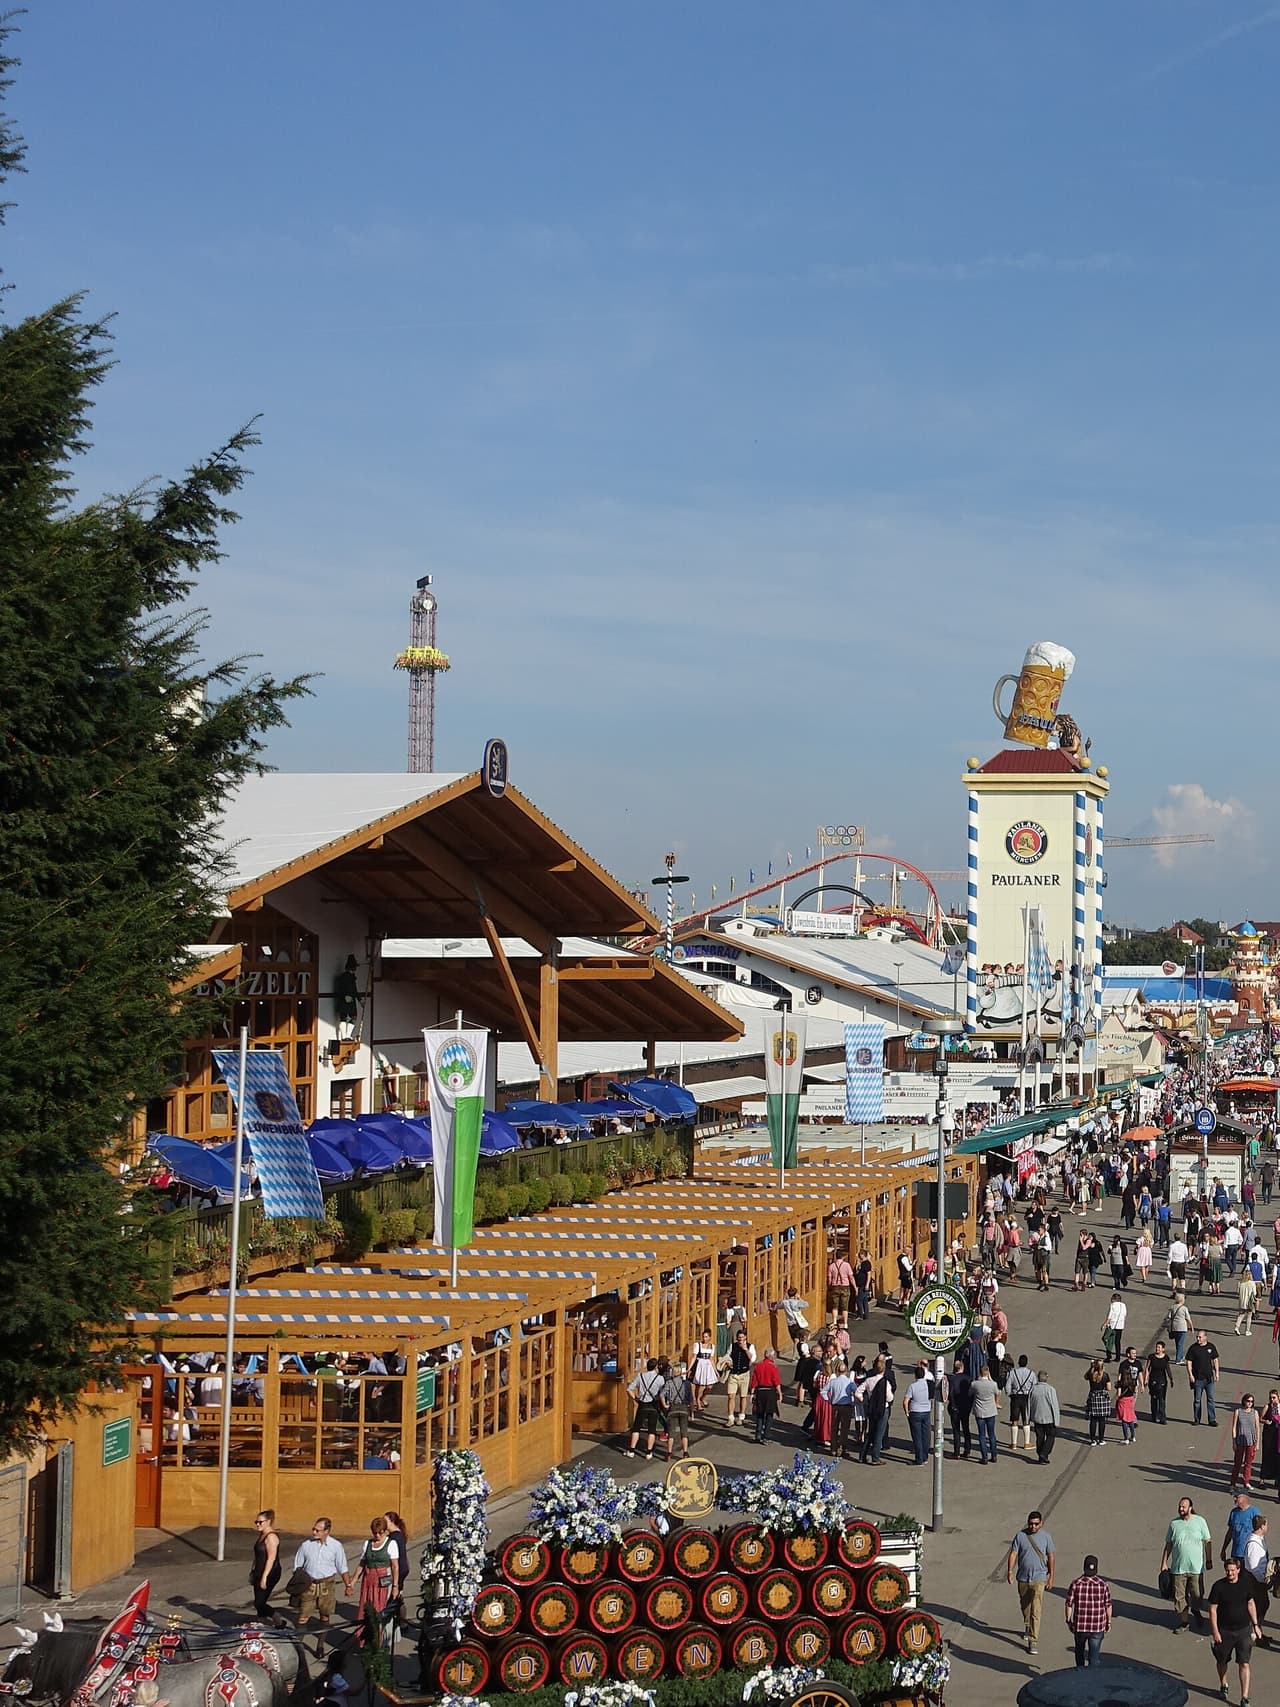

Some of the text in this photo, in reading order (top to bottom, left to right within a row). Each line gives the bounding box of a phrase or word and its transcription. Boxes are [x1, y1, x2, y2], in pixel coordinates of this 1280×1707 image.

[1007, 821, 1046, 838] PAULANER
[991, 874, 1060, 886] PAULANER
[916, 1325, 963, 1335] Münchner Bier
